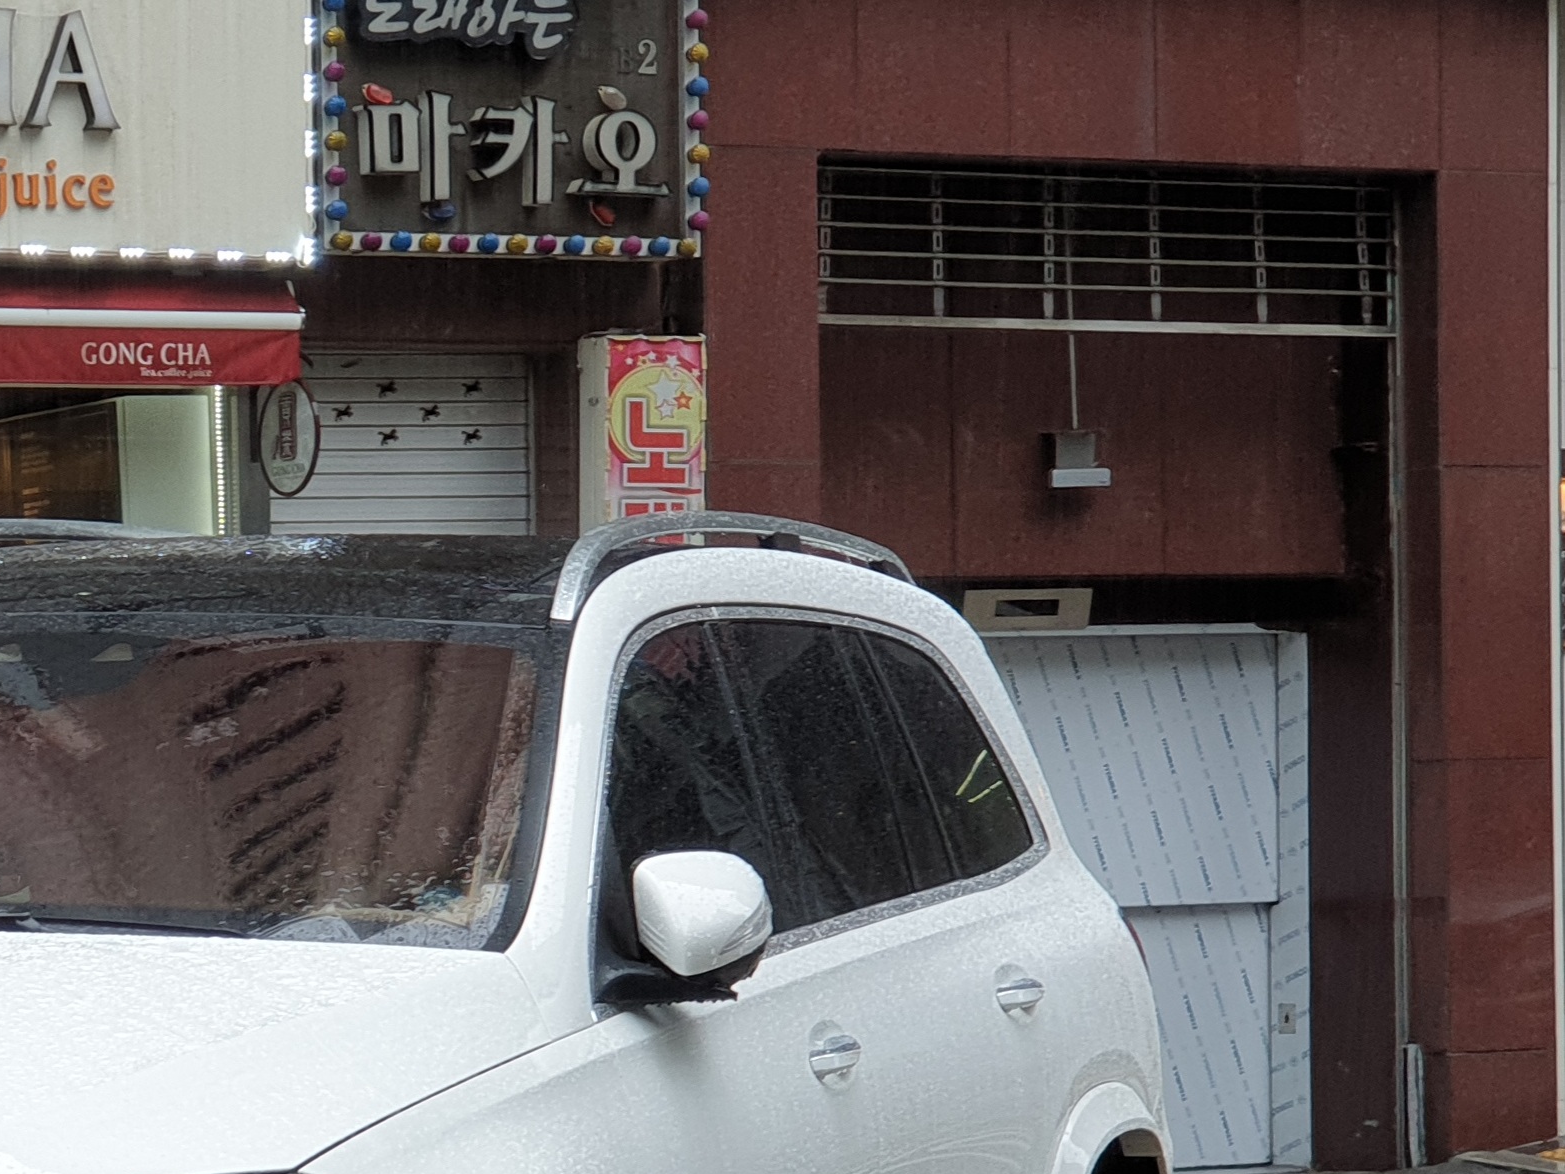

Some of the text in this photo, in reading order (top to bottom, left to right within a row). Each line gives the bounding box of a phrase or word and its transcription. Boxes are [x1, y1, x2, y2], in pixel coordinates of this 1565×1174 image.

[352, 89, 671, 207] 마카오
[81, 342, 212, 366] GONG CHA
